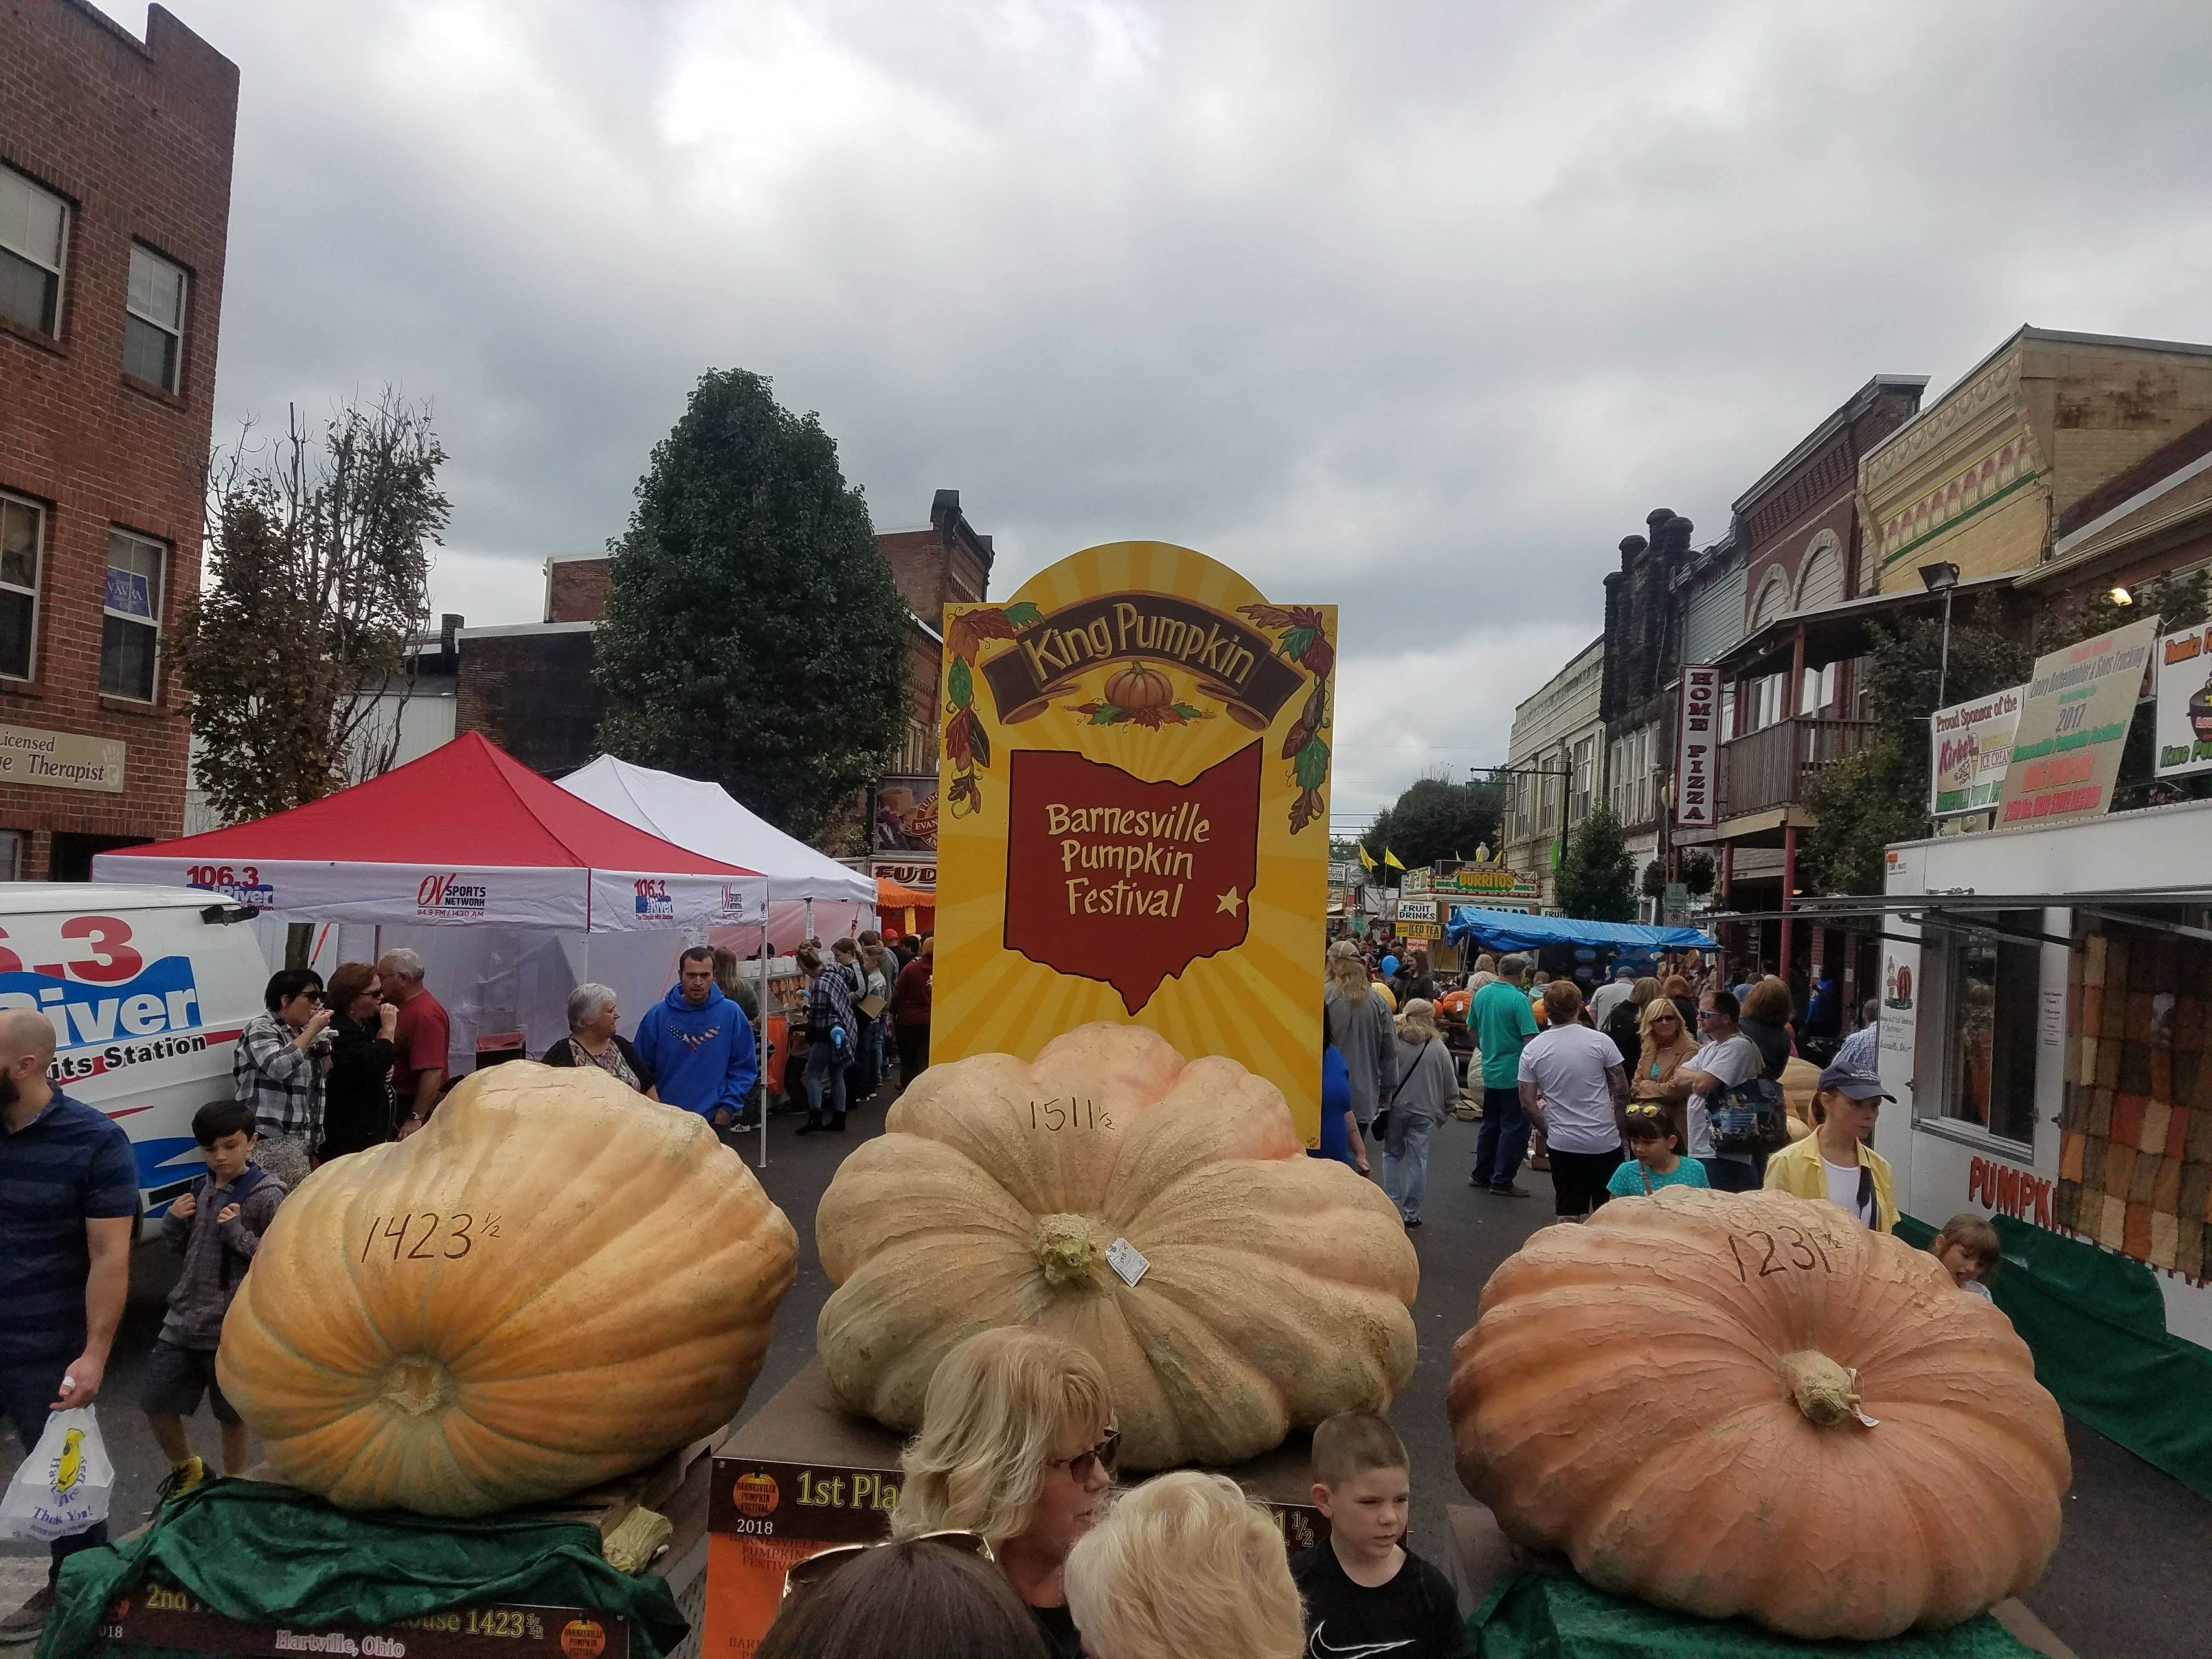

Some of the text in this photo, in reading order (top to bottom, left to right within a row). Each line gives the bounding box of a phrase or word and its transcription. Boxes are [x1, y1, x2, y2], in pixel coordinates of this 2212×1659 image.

[1024, 602, 1255, 685] King Pumpkin
[1936, 693, 2018, 733] Proud Sponsor of the
[2056, 703, 2088, 733] 2017
[1683, 672, 1714, 820] HOME PIZZA
[28, 753, 105, 783] Therapist
[1980, 754, 1990, 769] ICE
[1045, 802, 1210, 843] Barnesville
[1060, 839, 1193, 879] Pumpkin
[187, 865, 259, 888] 106.3
[1459, 873, 1514, 889] BURRITOS
[417, 872, 486, 906] OV SPORTS
[634, 879, 665, 899] 106.3
[730, 894, 742, 902] SPORTS
[1065, 877, 1183, 917] Festival
[445, 897, 485, 907] NETWORK
[651, 898, 674, 913] River
[1399, 911, 1435, 920] DRINKS
[1408, 924, 1424, 934] ICED
[1426, 926, 1440, 935] TEA
[47, 1034, 206, 1080] its Station
[1030, 1097, 1093, 1131] 1511
[360, 1212, 473, 1263] 1423
[1728, 1226, 1832, 1283] 1231
[736, 1482, 777, 1493] BARNESVILLE
[797, 1470, 900, 1510] 1st Pla
[741, 1493, 772, 1503] PUMPKIN
[741, 1502, 769, 1513] FESTIVAL
[737, 1519, 774, 1535] 2018
[742, 1545, 805, 1561] PUMPKIN
[742, 1556, 794, 1571] FESTIVA
[275, 1629, 405, 1658] Hartville, Ohio
[564, 1629, 603, 1639] BARNESVILLE
[568, 1638, 598, 1647] PUMPKIN
[568, 1647, 597, 1656] FESTIVAL
